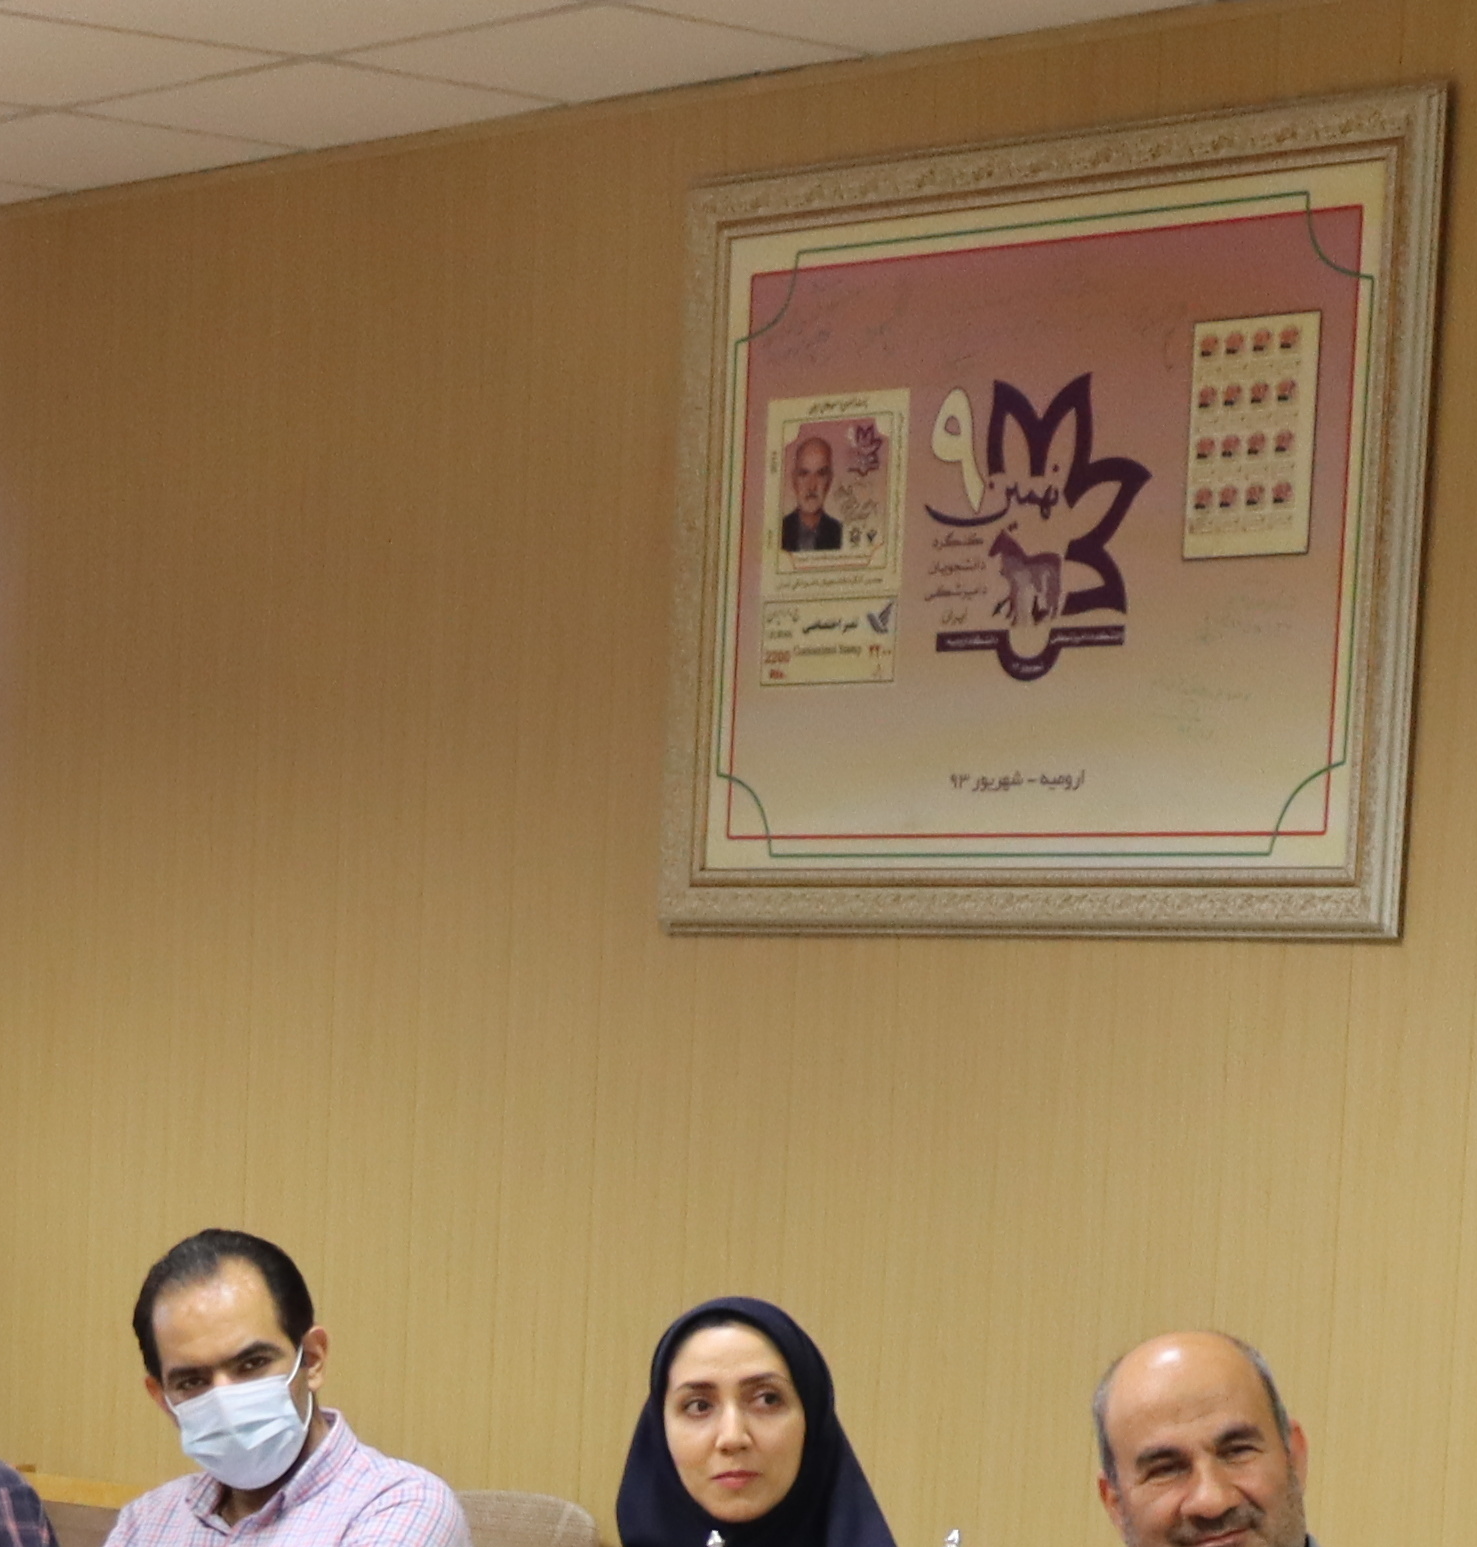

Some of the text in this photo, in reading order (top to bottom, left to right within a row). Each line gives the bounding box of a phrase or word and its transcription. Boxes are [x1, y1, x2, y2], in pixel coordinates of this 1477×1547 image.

[950, 773, 970, 789] ۹۳
[971, 770, 1024, 792] شهریور
[1040, 769, 1086, 790] ارومیه
